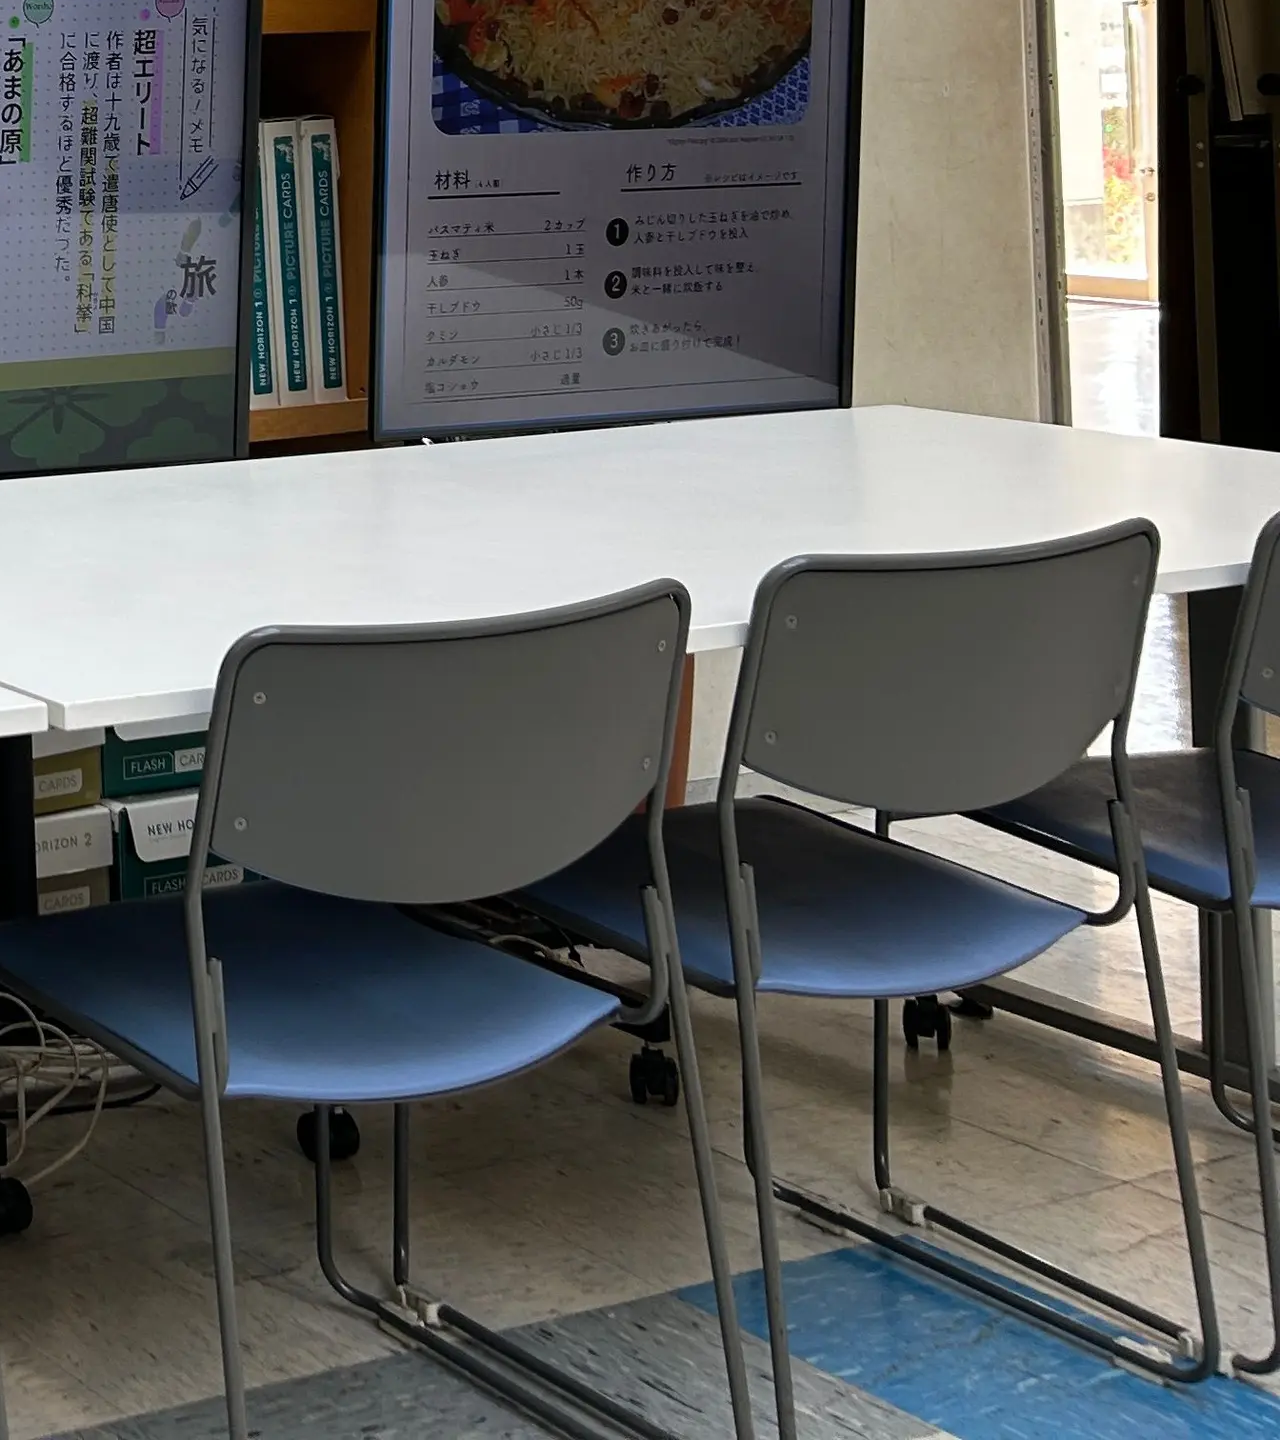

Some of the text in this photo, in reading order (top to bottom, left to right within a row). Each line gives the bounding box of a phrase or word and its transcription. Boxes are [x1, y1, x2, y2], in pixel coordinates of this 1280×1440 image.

[0, 36, 27, 166] 「あまの原」
[133, 30, 157, 156] 超エリート
[282, 171, 293, 219] CARDS
[319, 169, 330, 217] CARDS
[434, 169, 471, 190] 材料
[626, 162, 677, 183] 作り方
[284, 221, 296, 280] PICTURE
[321, 219, 333, 278] PICTURE
[179, 255, 217, 299] 旅
[255, 310, 266, 357] HORIZON
[290, 307, 300, 357] HORIZON
[326, 305, 336, 355] HORIZON
[259, 366, 268, 387] NEW
[293, 361, 303, 384] NEW
[328, 360, 337, 381] NEW
[38, 774, 78, 793] CARDS
[130, 757, 166, 774] FLASH
[147, 821, 173, 837] NEW
